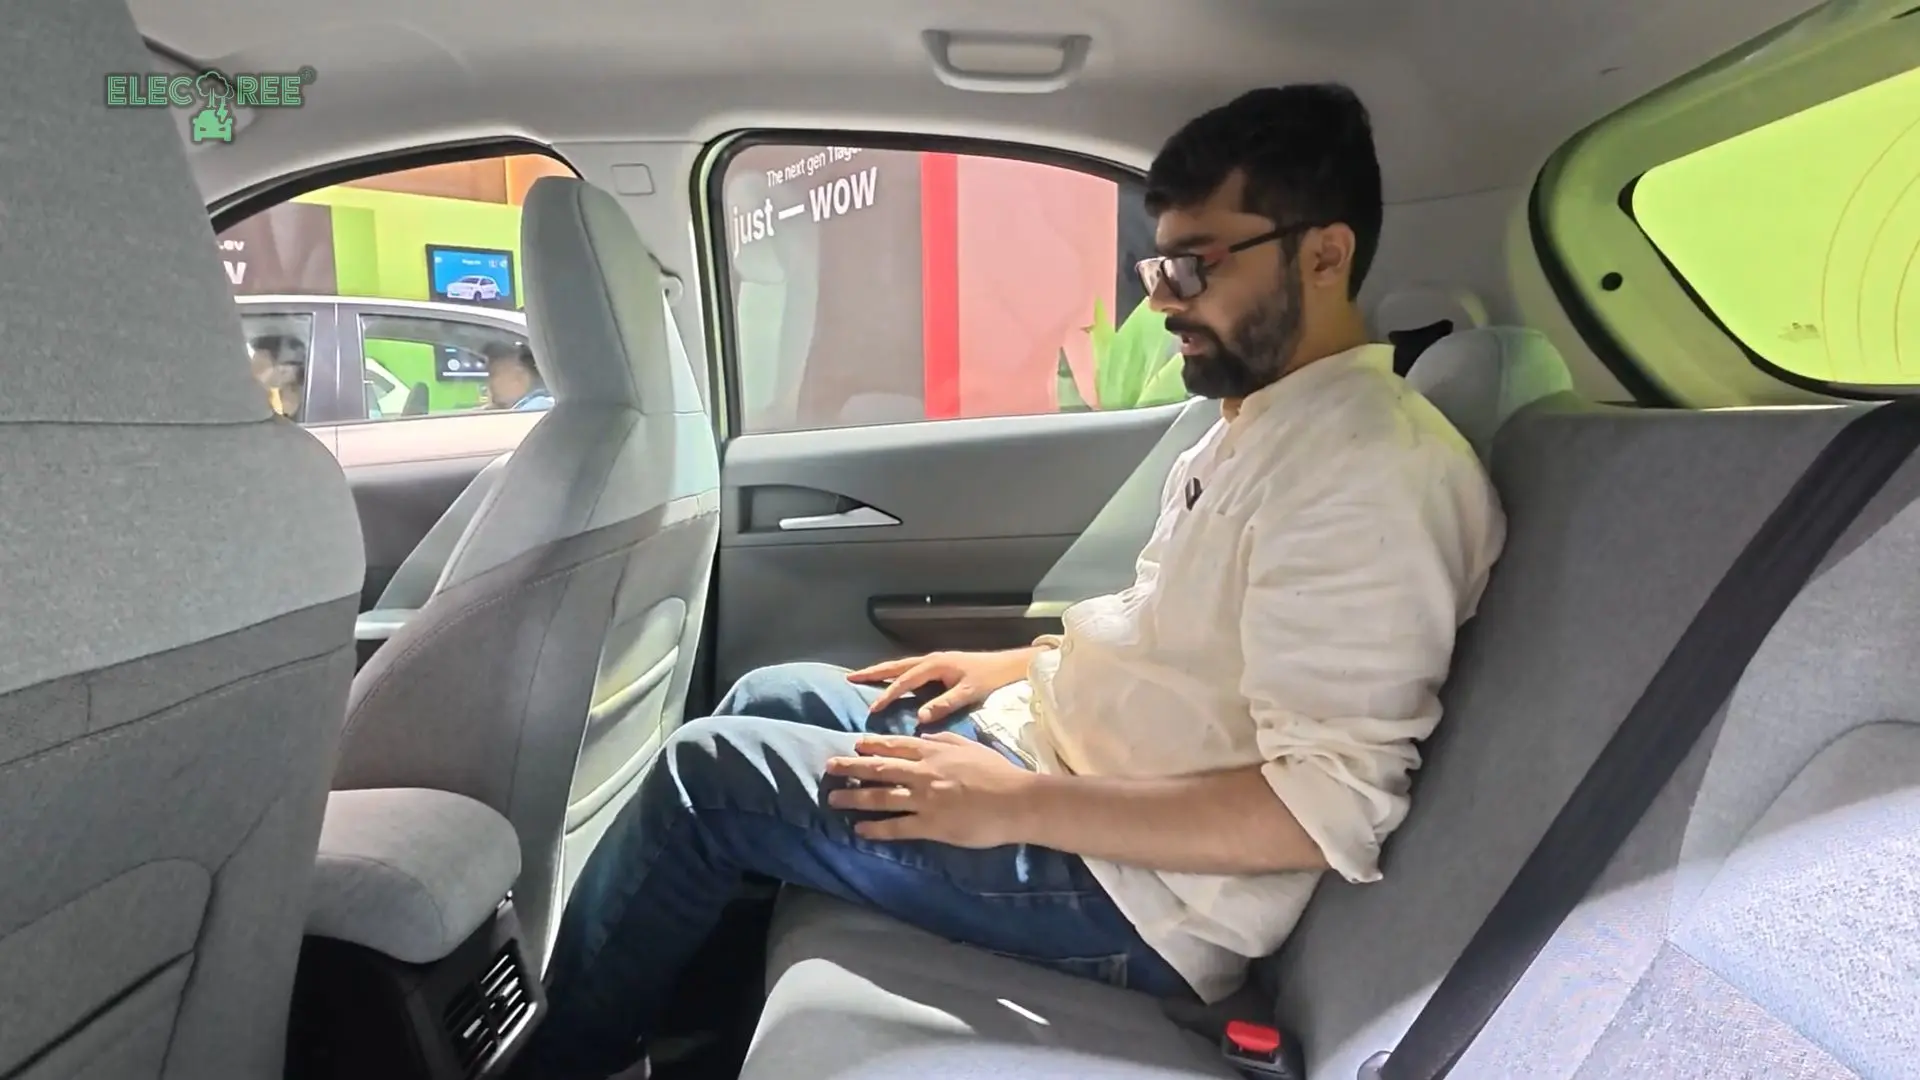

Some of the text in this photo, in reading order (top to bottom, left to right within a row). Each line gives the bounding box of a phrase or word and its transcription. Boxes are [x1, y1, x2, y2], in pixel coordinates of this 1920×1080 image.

[766, 169, 783, 188] The
[785, 159, 806, 181] next
[807, 152, 826, 176] gen
[732, 198, 775, 259] just
[809, 166, 878, 222] WOW
